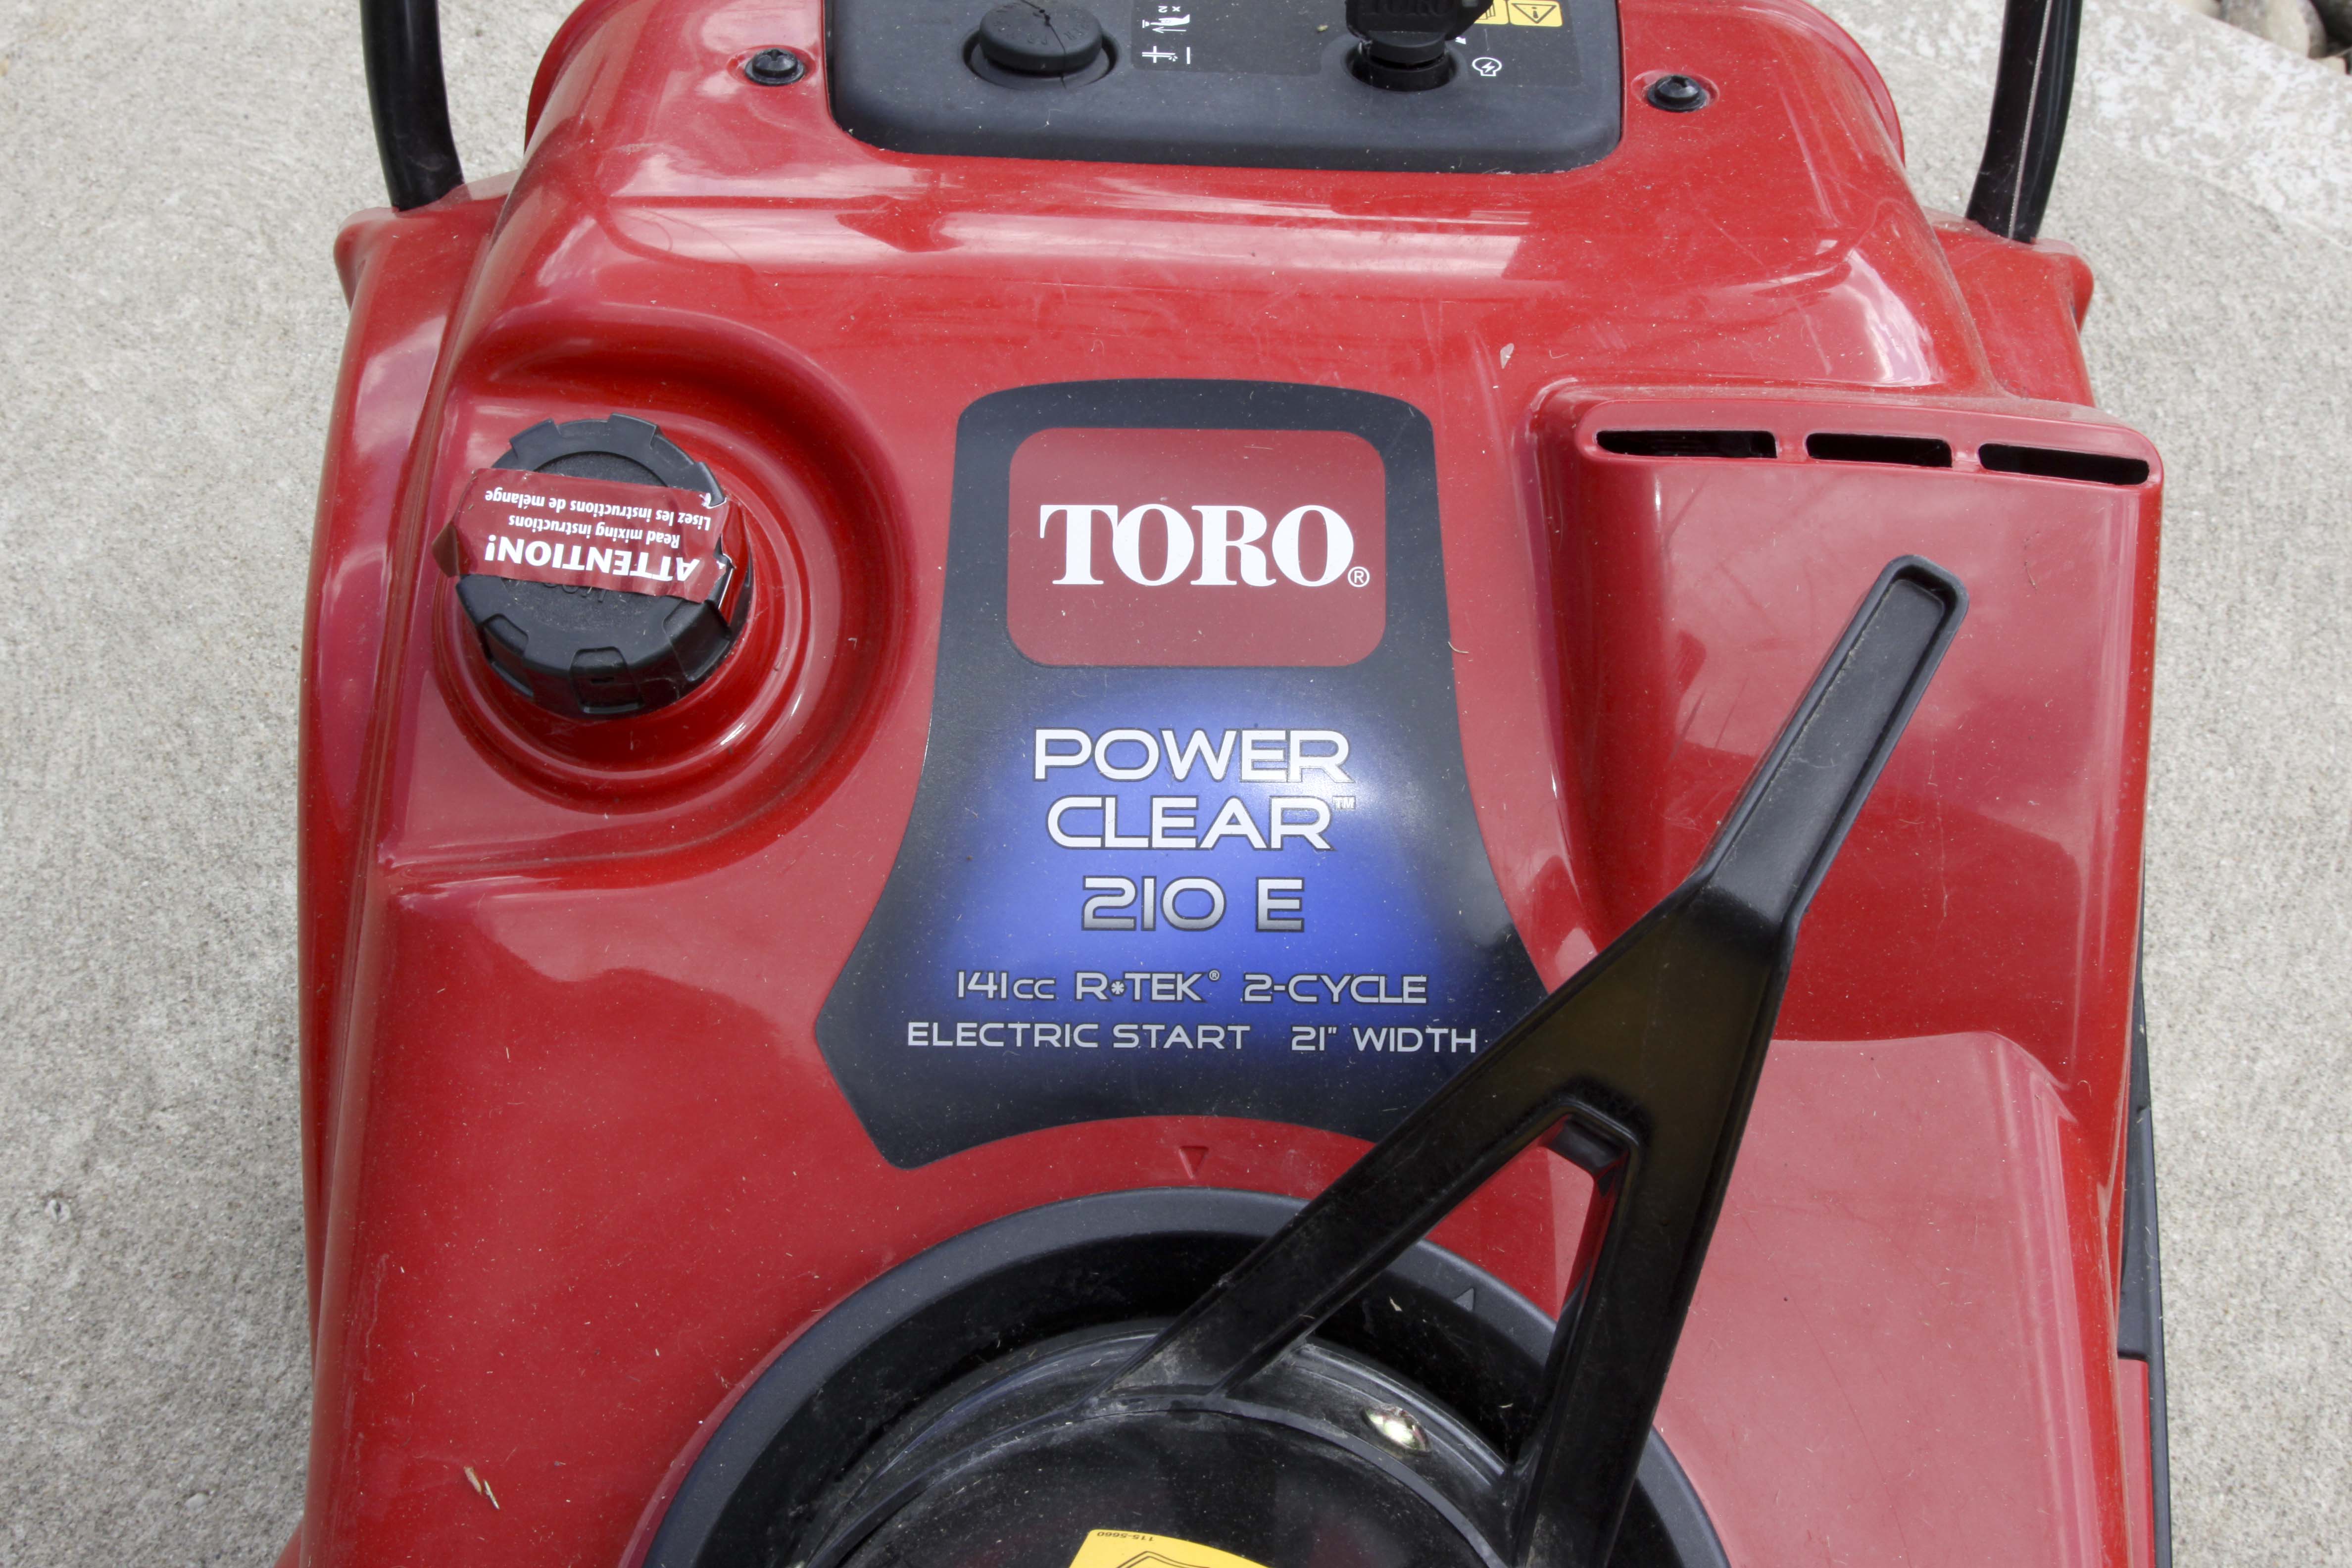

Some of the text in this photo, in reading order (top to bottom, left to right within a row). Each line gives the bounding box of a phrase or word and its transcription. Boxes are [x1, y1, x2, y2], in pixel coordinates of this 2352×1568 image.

[485, 487, 711, 531] Lisez les instructions de mélange
[508, 515, 681, 549] Read mixing instructions
[485, 534, 700, 582] ATTENTION!
[1033, 727, 1355, 784] POWER
[1081, 875, 1305, 933] 210 E
[1244, 974, 1427, 1004] 2-CYCLE
[907, 1021, 1099, 1048] ELECTRIC
[1112, 1024, 1251, 1050] START
[1352, 1027, 1476, 1053] WIDTH
[1097, 1532, 1154, 1541] 115-5660
